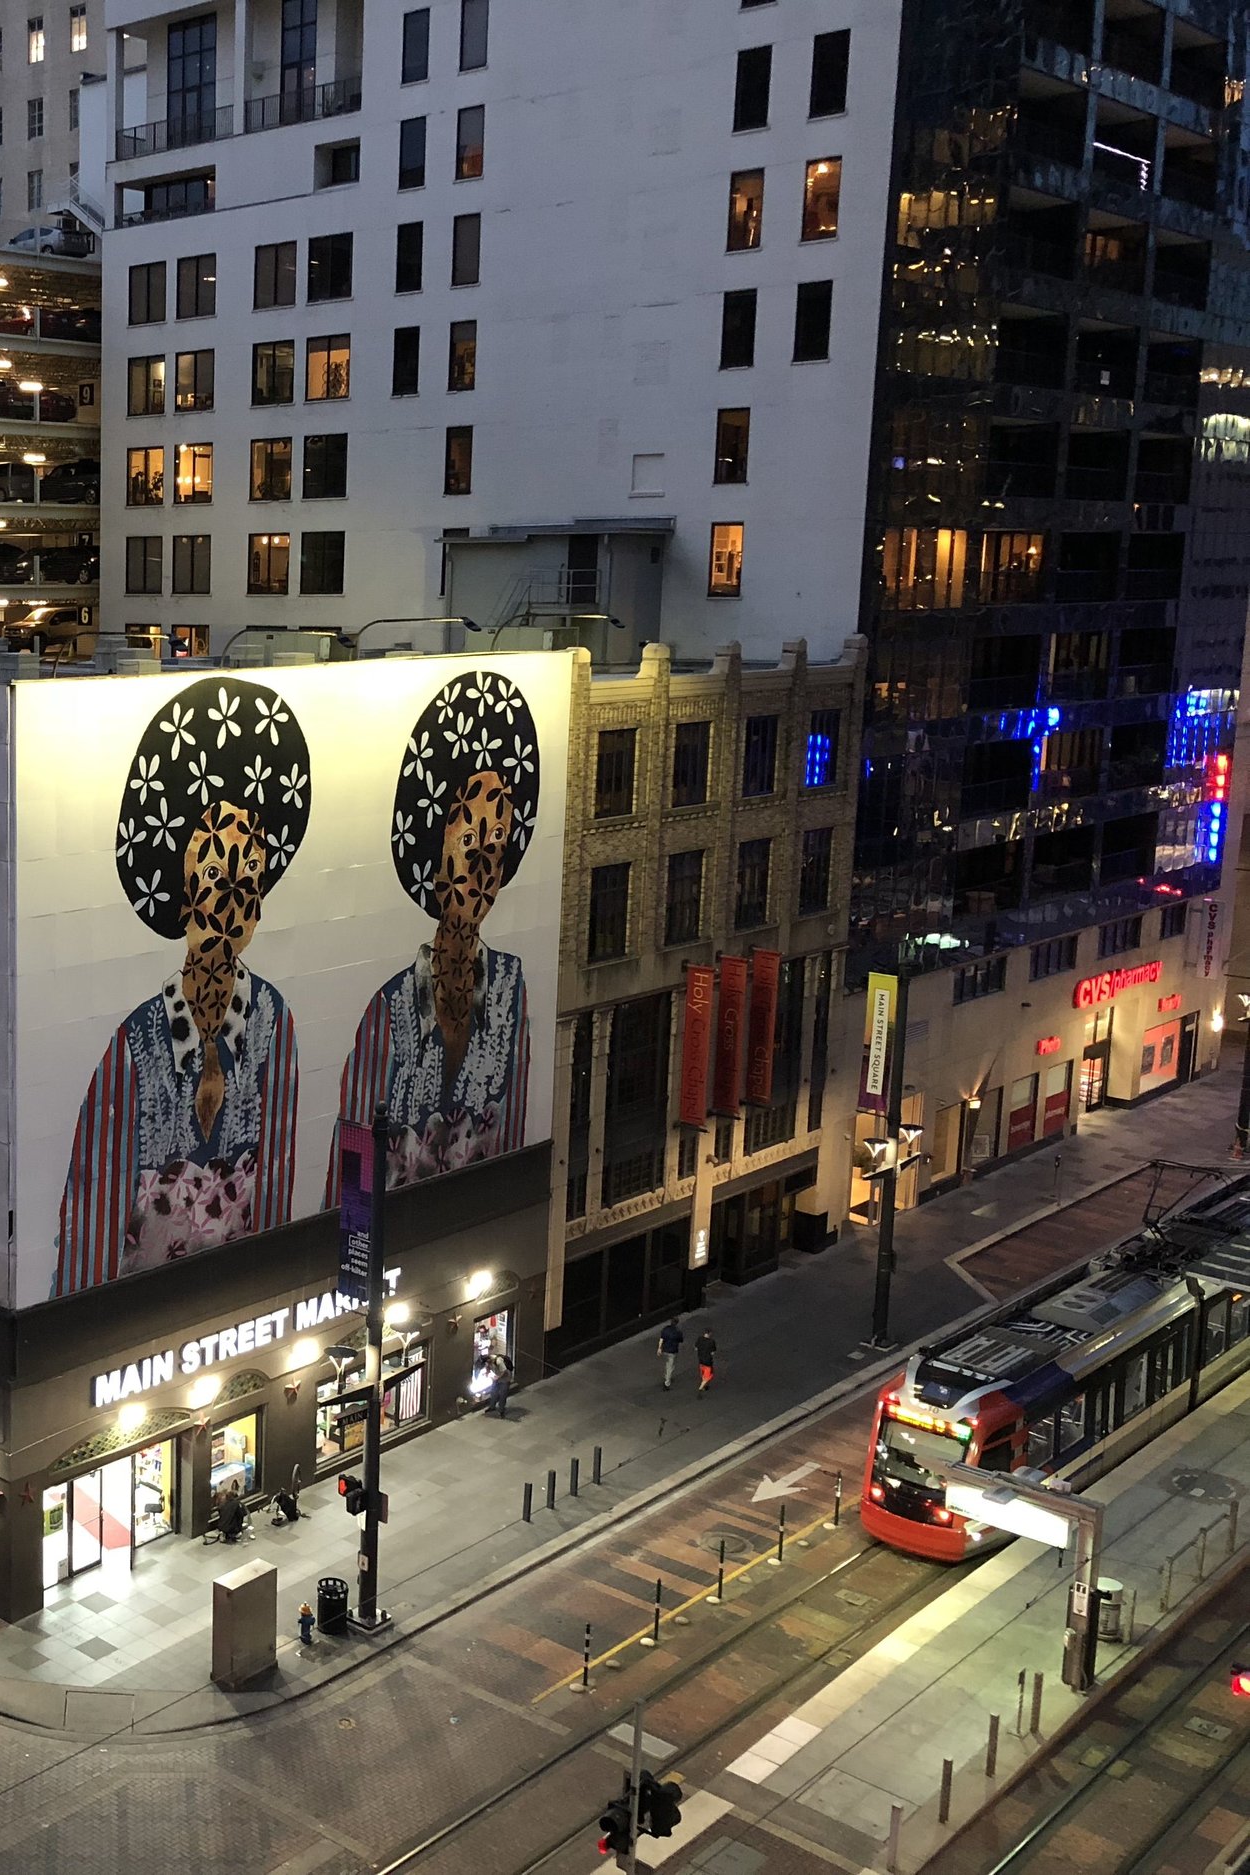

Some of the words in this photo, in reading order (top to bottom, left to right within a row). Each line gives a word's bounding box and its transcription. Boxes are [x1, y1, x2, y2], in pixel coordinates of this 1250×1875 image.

[82, 385, 91, 404] 9
[81, 606, 90, 624] 6
[1207, 904, 1218, 930] CVS
[1203, 931, 1214, 978] pharmacy
[687, 971, 710, 1014] Holy
[1075, 960, 1163, 1008] CVS/pharmacy
[877, 993, 886, 1017] MAIN
[689, 1018, 706, 1062] Cross
[724, 1007, 738, 1051] Cross
[875, 1019, 884, 1053] STREET
[750, 1045, 769, 1101] Chapel
[870, 1054, 881, 1090] SQUARE
[683, 1066, 705, 1122] Chapel
[351, 1239, 368, 1249] other
[357, 1231, 369, 1239] and
[348, 1248, 368, 1259] places
[351, 1258, 368, 1268] seem
[341, 1263, 367, 1277] off-kilter
[92, 1350, 175, 1408] MAIN
[180, 1307, 291, 1375] STREET
[295, 1267, 402, 1332] MART
[342, 1411, 364, 1425] MAIN
